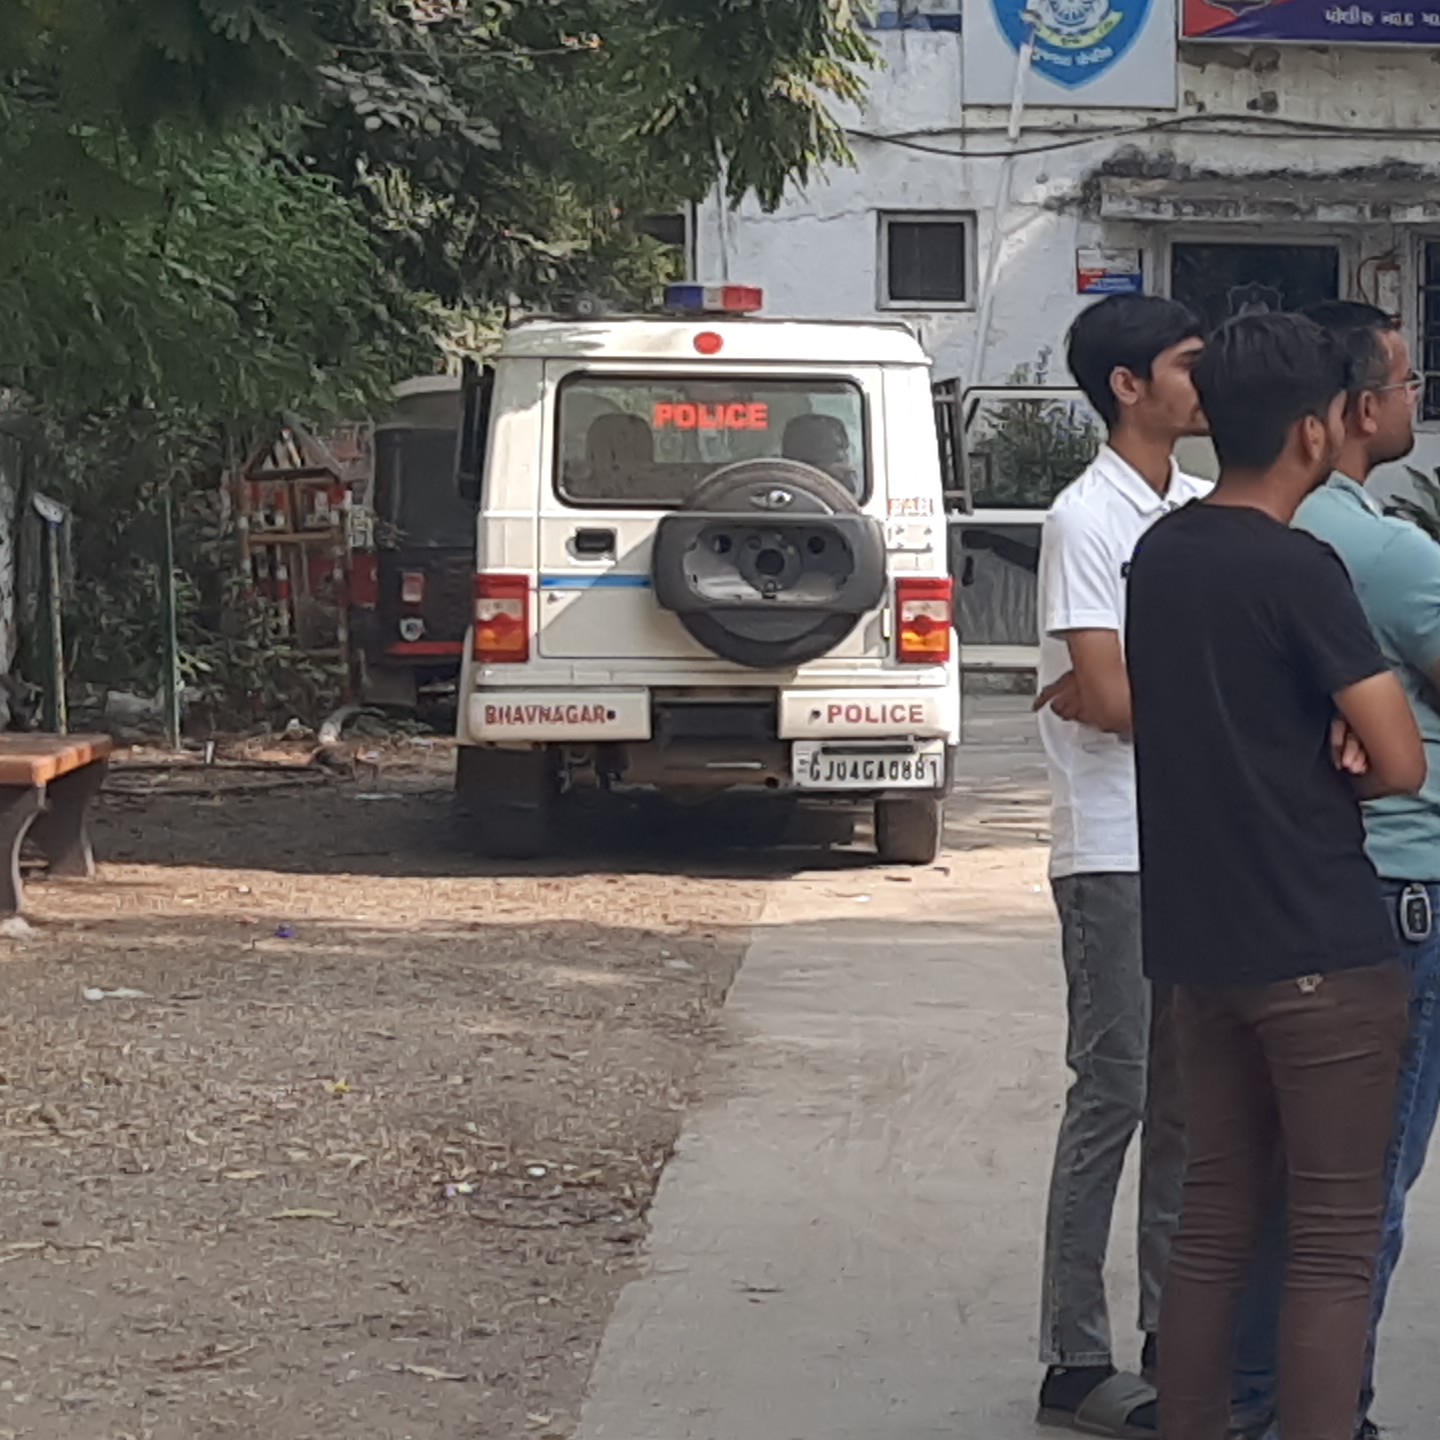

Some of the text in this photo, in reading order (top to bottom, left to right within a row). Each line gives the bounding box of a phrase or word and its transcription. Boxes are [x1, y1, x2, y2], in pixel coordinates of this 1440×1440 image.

[654, 402, 769, 431] POLICE
[485, 705, 606, 725] BHAVNAGAR
[826, 704, 924, 724] POLICE
